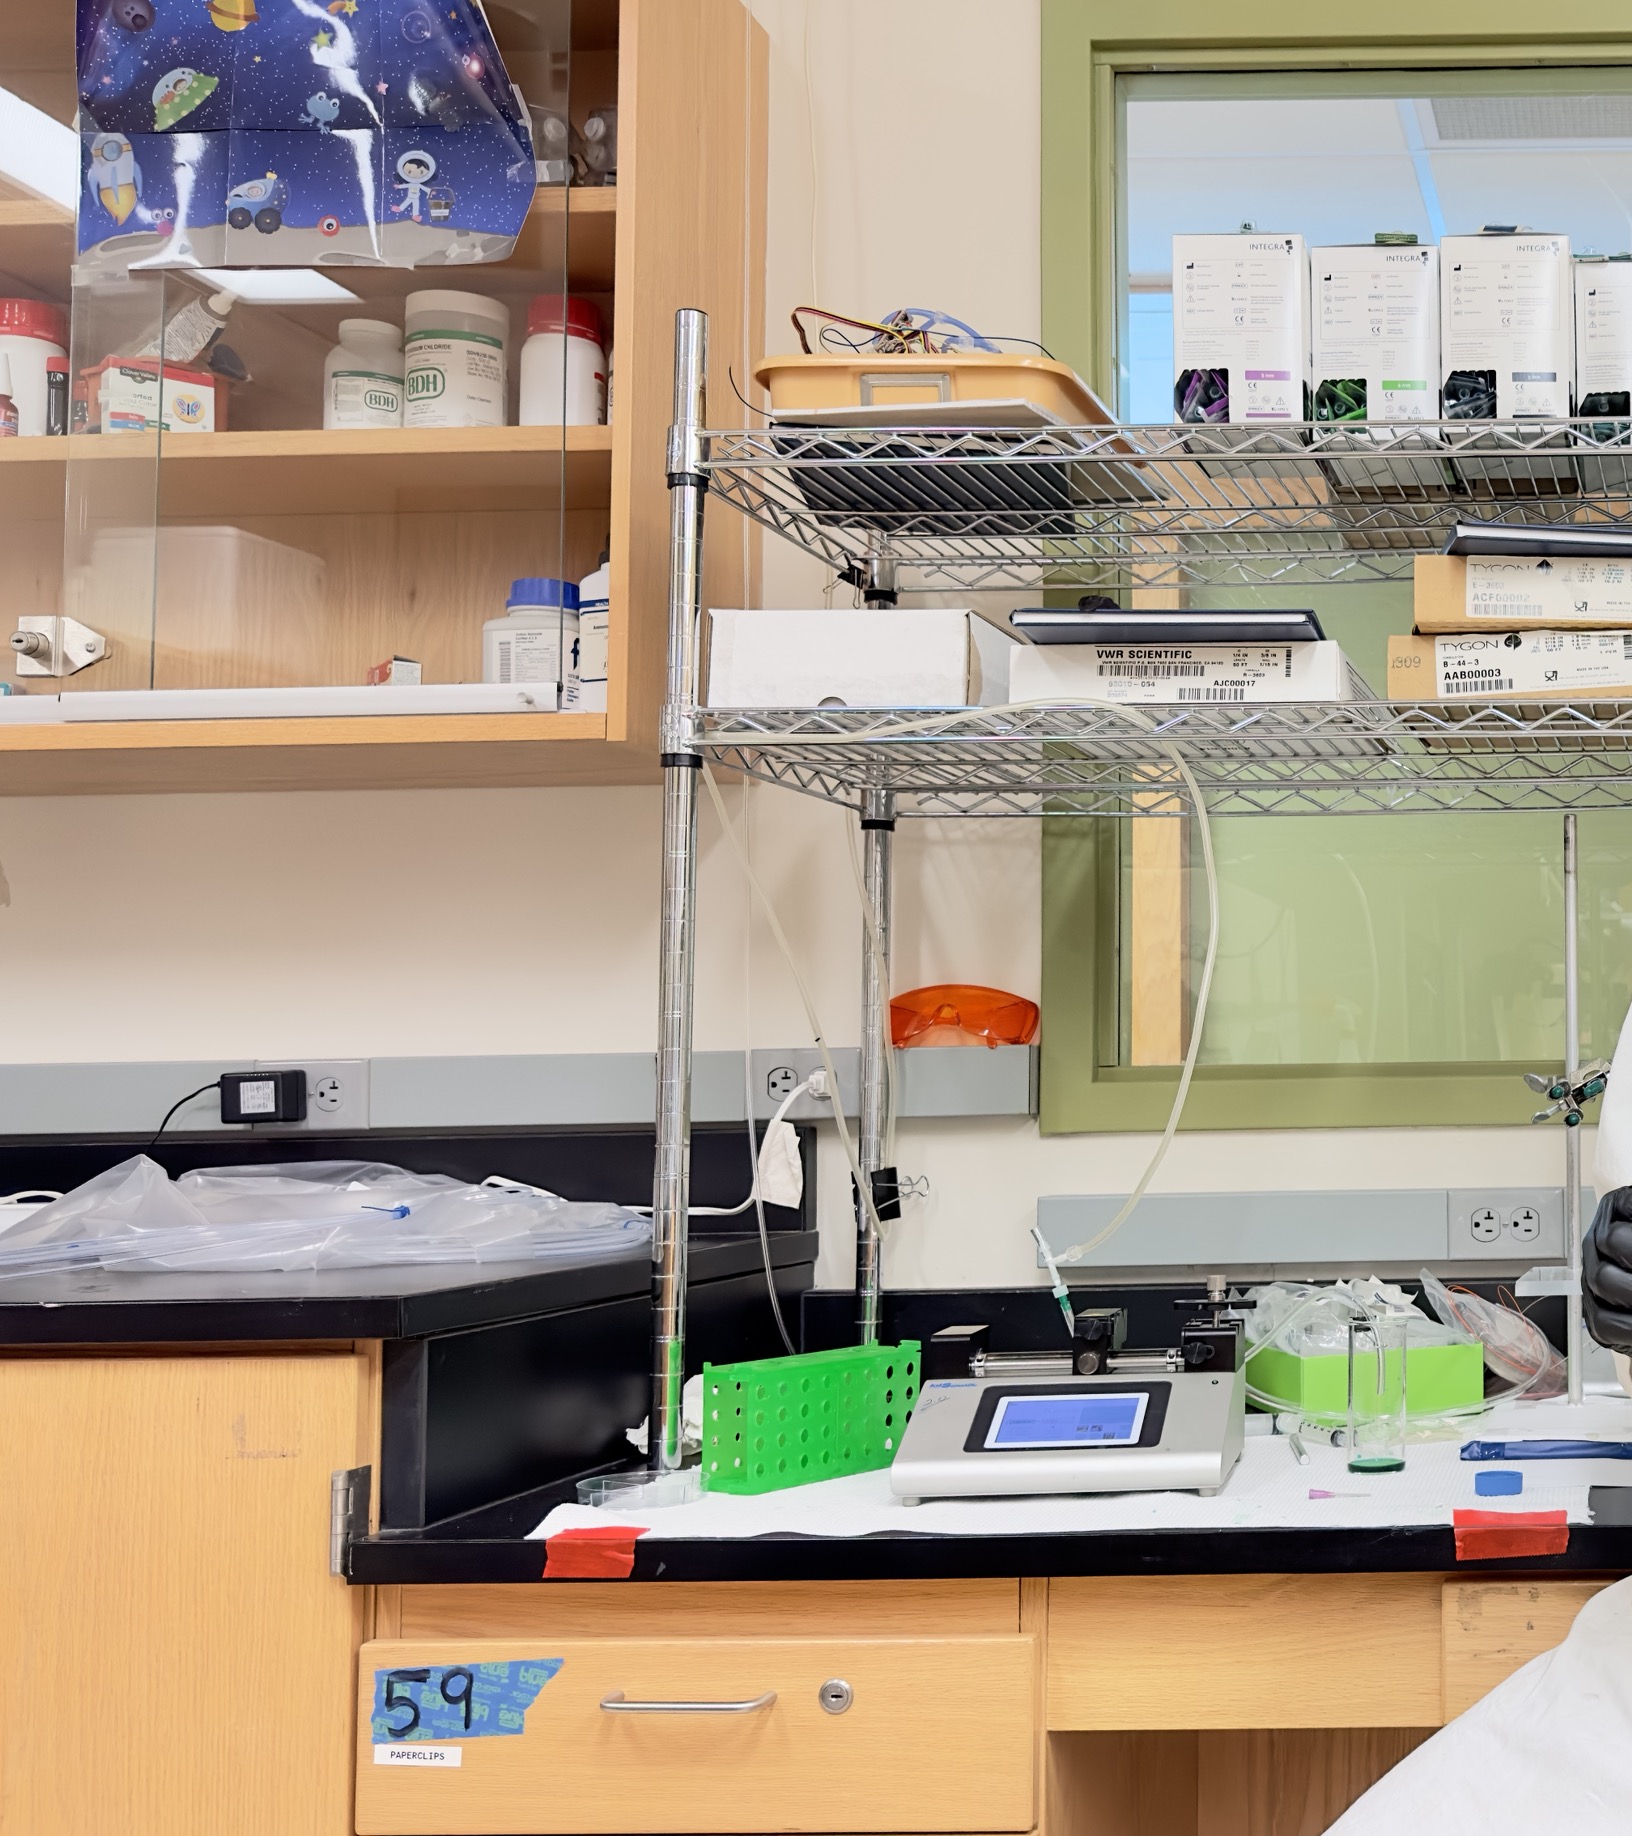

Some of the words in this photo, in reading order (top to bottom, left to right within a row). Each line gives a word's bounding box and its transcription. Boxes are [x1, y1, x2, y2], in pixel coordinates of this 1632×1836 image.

[408, 374, 438, 396] BDH
[369, 394, 394, 409] BDH
[1440, 640, 1498, 652] TYGON
[1097, 650, 1124, 659] VWR
[1128, 650, 1192, 659] SCIENTIFIC
[1444, 668, 1501, 680] AAB00003
[385, 1667, 473, 1738] 59
[390, 1751, 445, 1760] PAPERCLIPS
